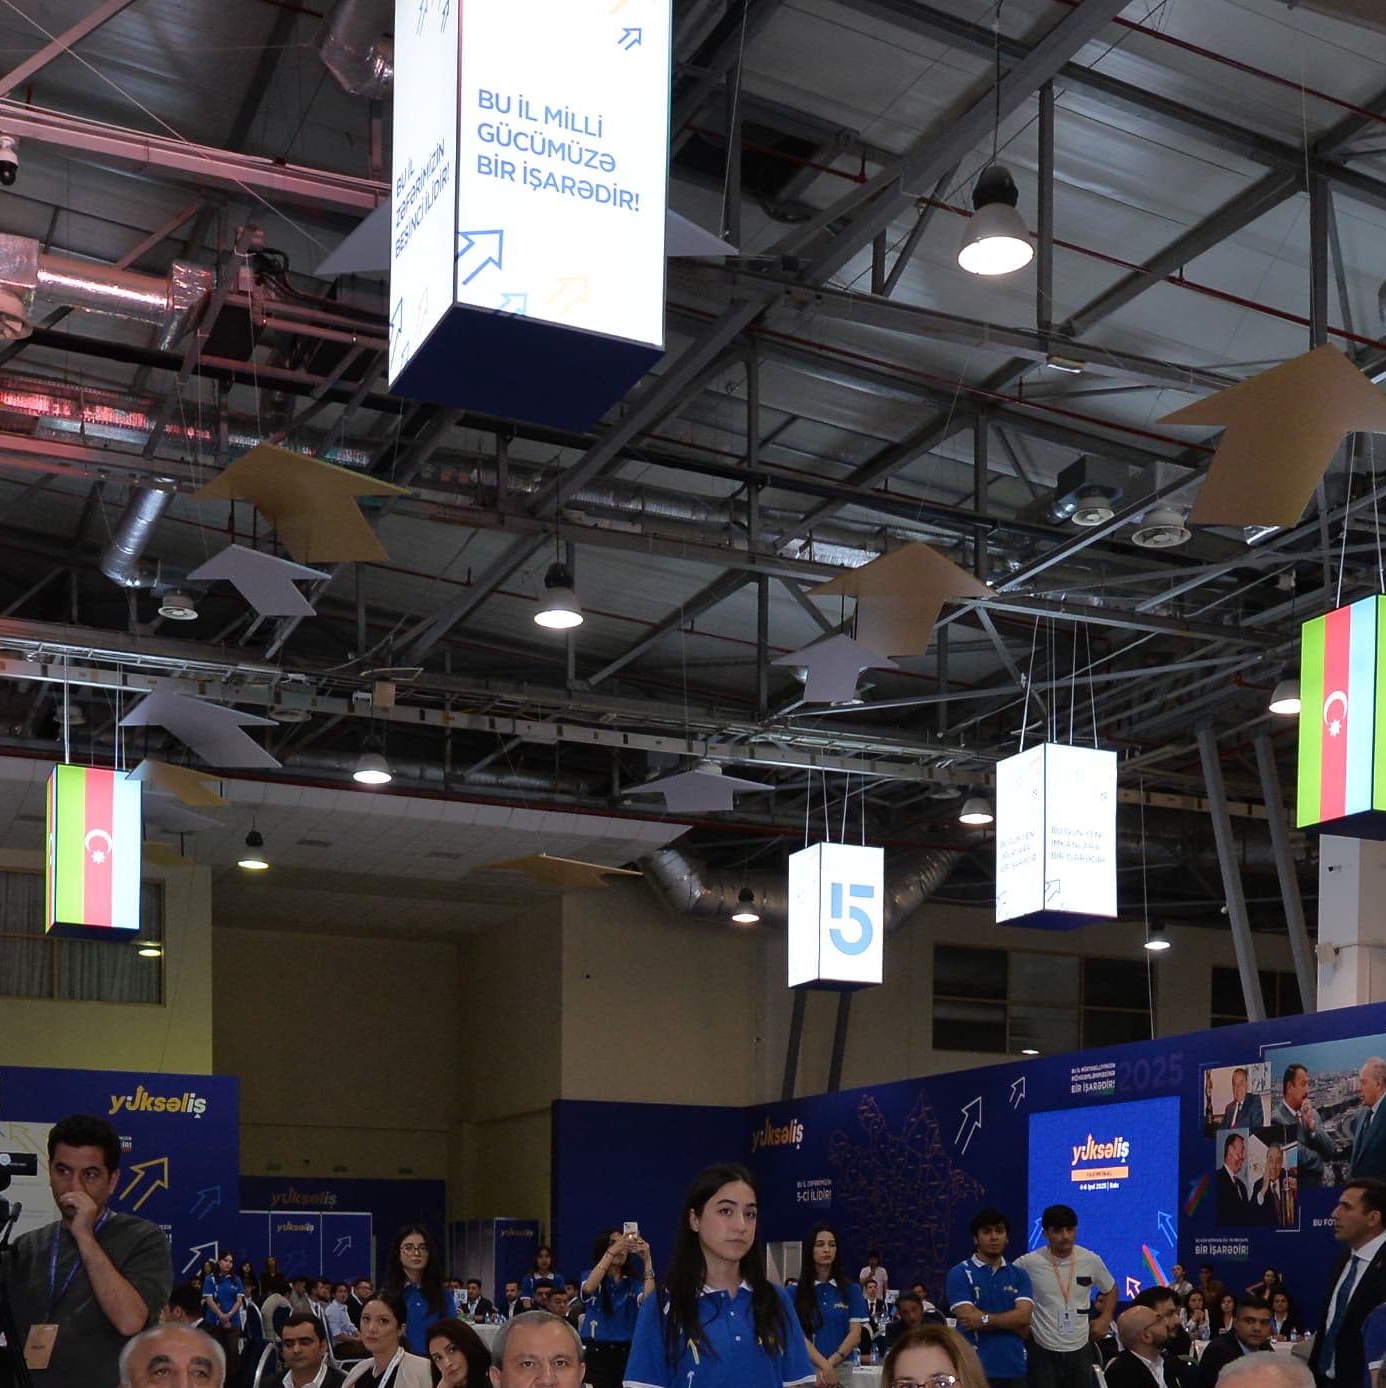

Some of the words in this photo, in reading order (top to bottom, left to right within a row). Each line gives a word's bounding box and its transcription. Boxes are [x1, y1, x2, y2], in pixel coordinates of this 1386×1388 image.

[477, 88, 512, 115] BU
[517, 94, 538, 123] İL
[544, 105, 604, 139] MİLLİ
[476, 121, 617, 173] GÜCÜMÜZƏ
[476, 153, 517, 182] BİR
[521, 162, 641, 213] İŞARƏDİR!
[829, 882, 875, 956] 5
[108, 1085, 207, 1119] yüksəliş
[751, 1116, 804, 1150] yüksəliş
[1071, 1133, 1130, 1166] yüksəliş
[269, 1186, 338, 1209] yüksəliş
[1313, 1219, 1323, 1227] BU
[1195, 1243, 1208, 1255] BİR
[1209, 1243, 1249, 1256] İŞARƏDİR!
